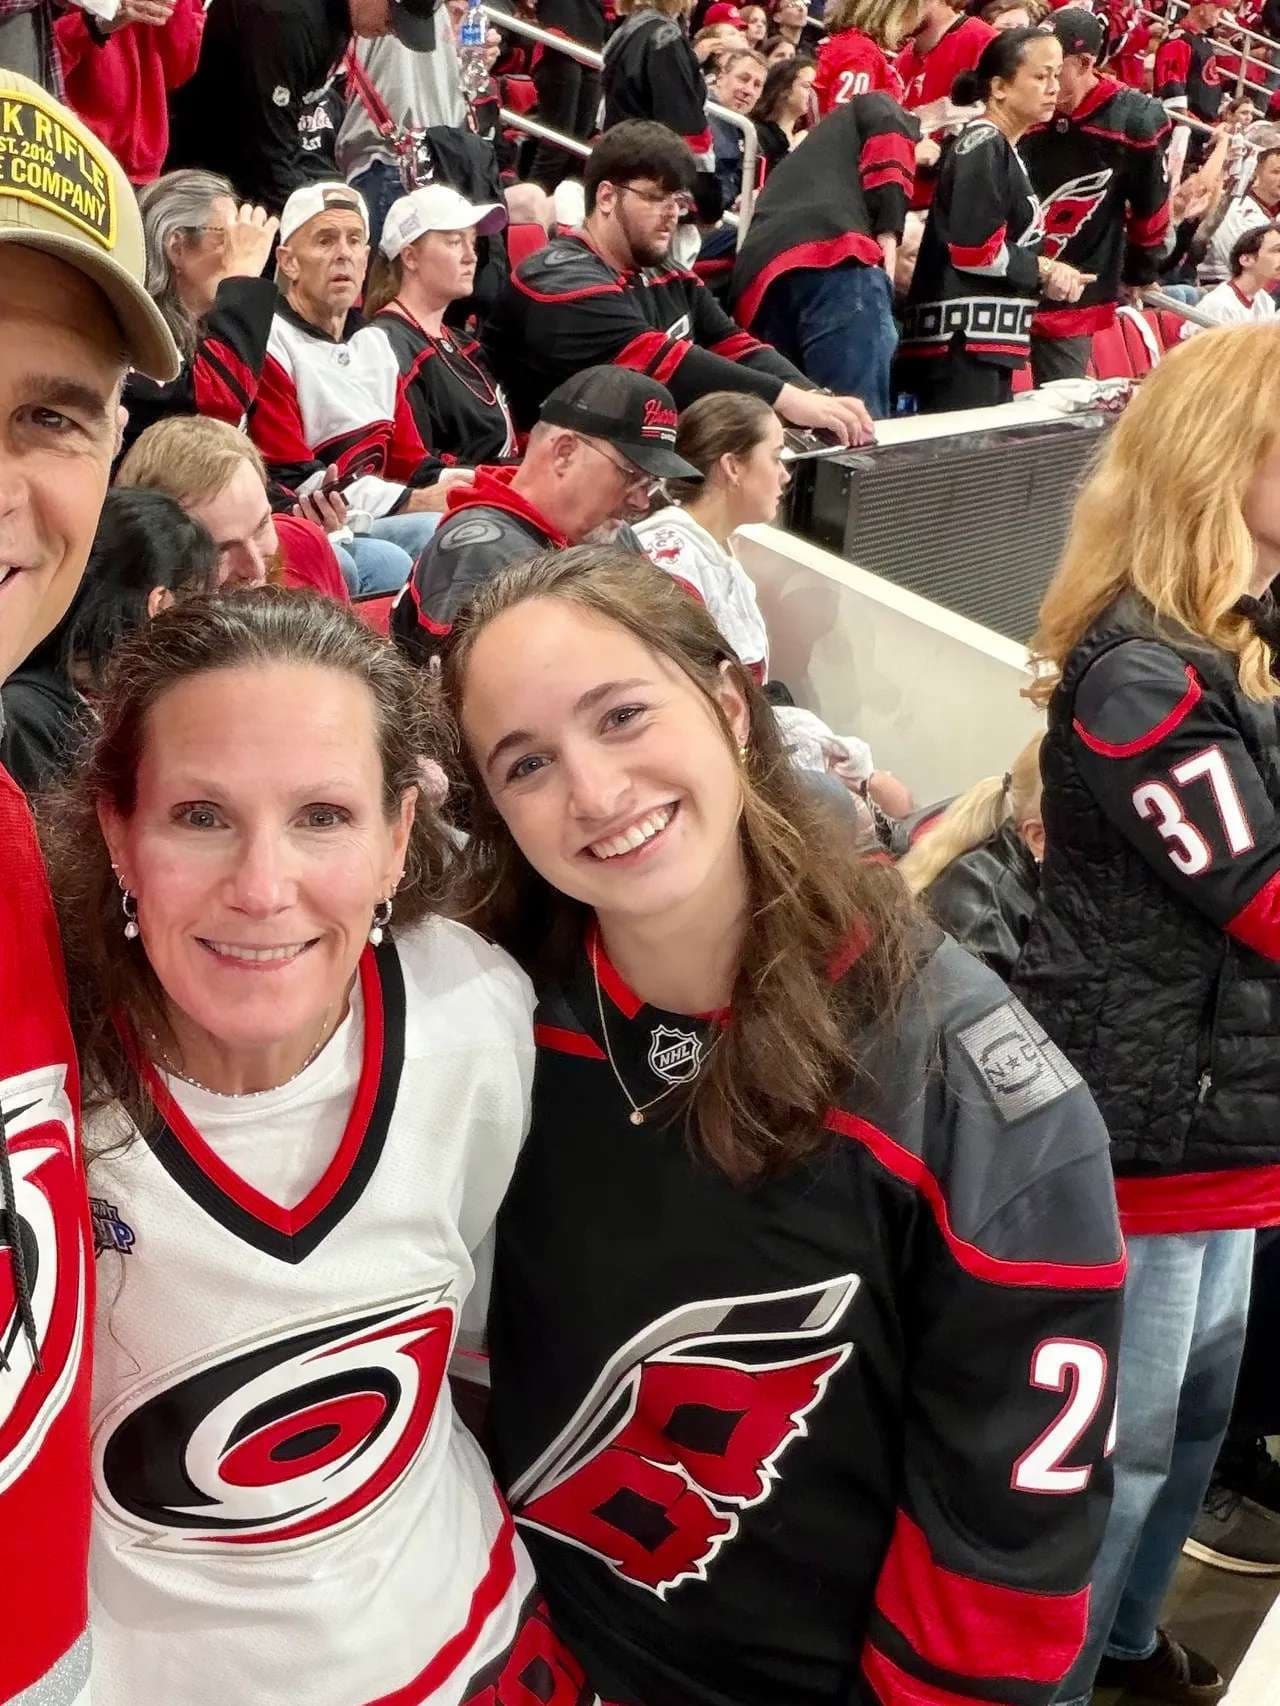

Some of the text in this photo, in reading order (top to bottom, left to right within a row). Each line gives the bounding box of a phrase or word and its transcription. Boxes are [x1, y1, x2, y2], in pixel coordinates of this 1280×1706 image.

[835, 71, 870, 103] 20
[20, 141, 55, 167] 2014
[33, 109, 106, 201] RIFLE
[11, 157, 107, 227] COMPANY
[1131, 744, 1257, 877] 37
[659, 1044, 691, 1068] NHL
[1010, 1336, 1119, 1495] 2
